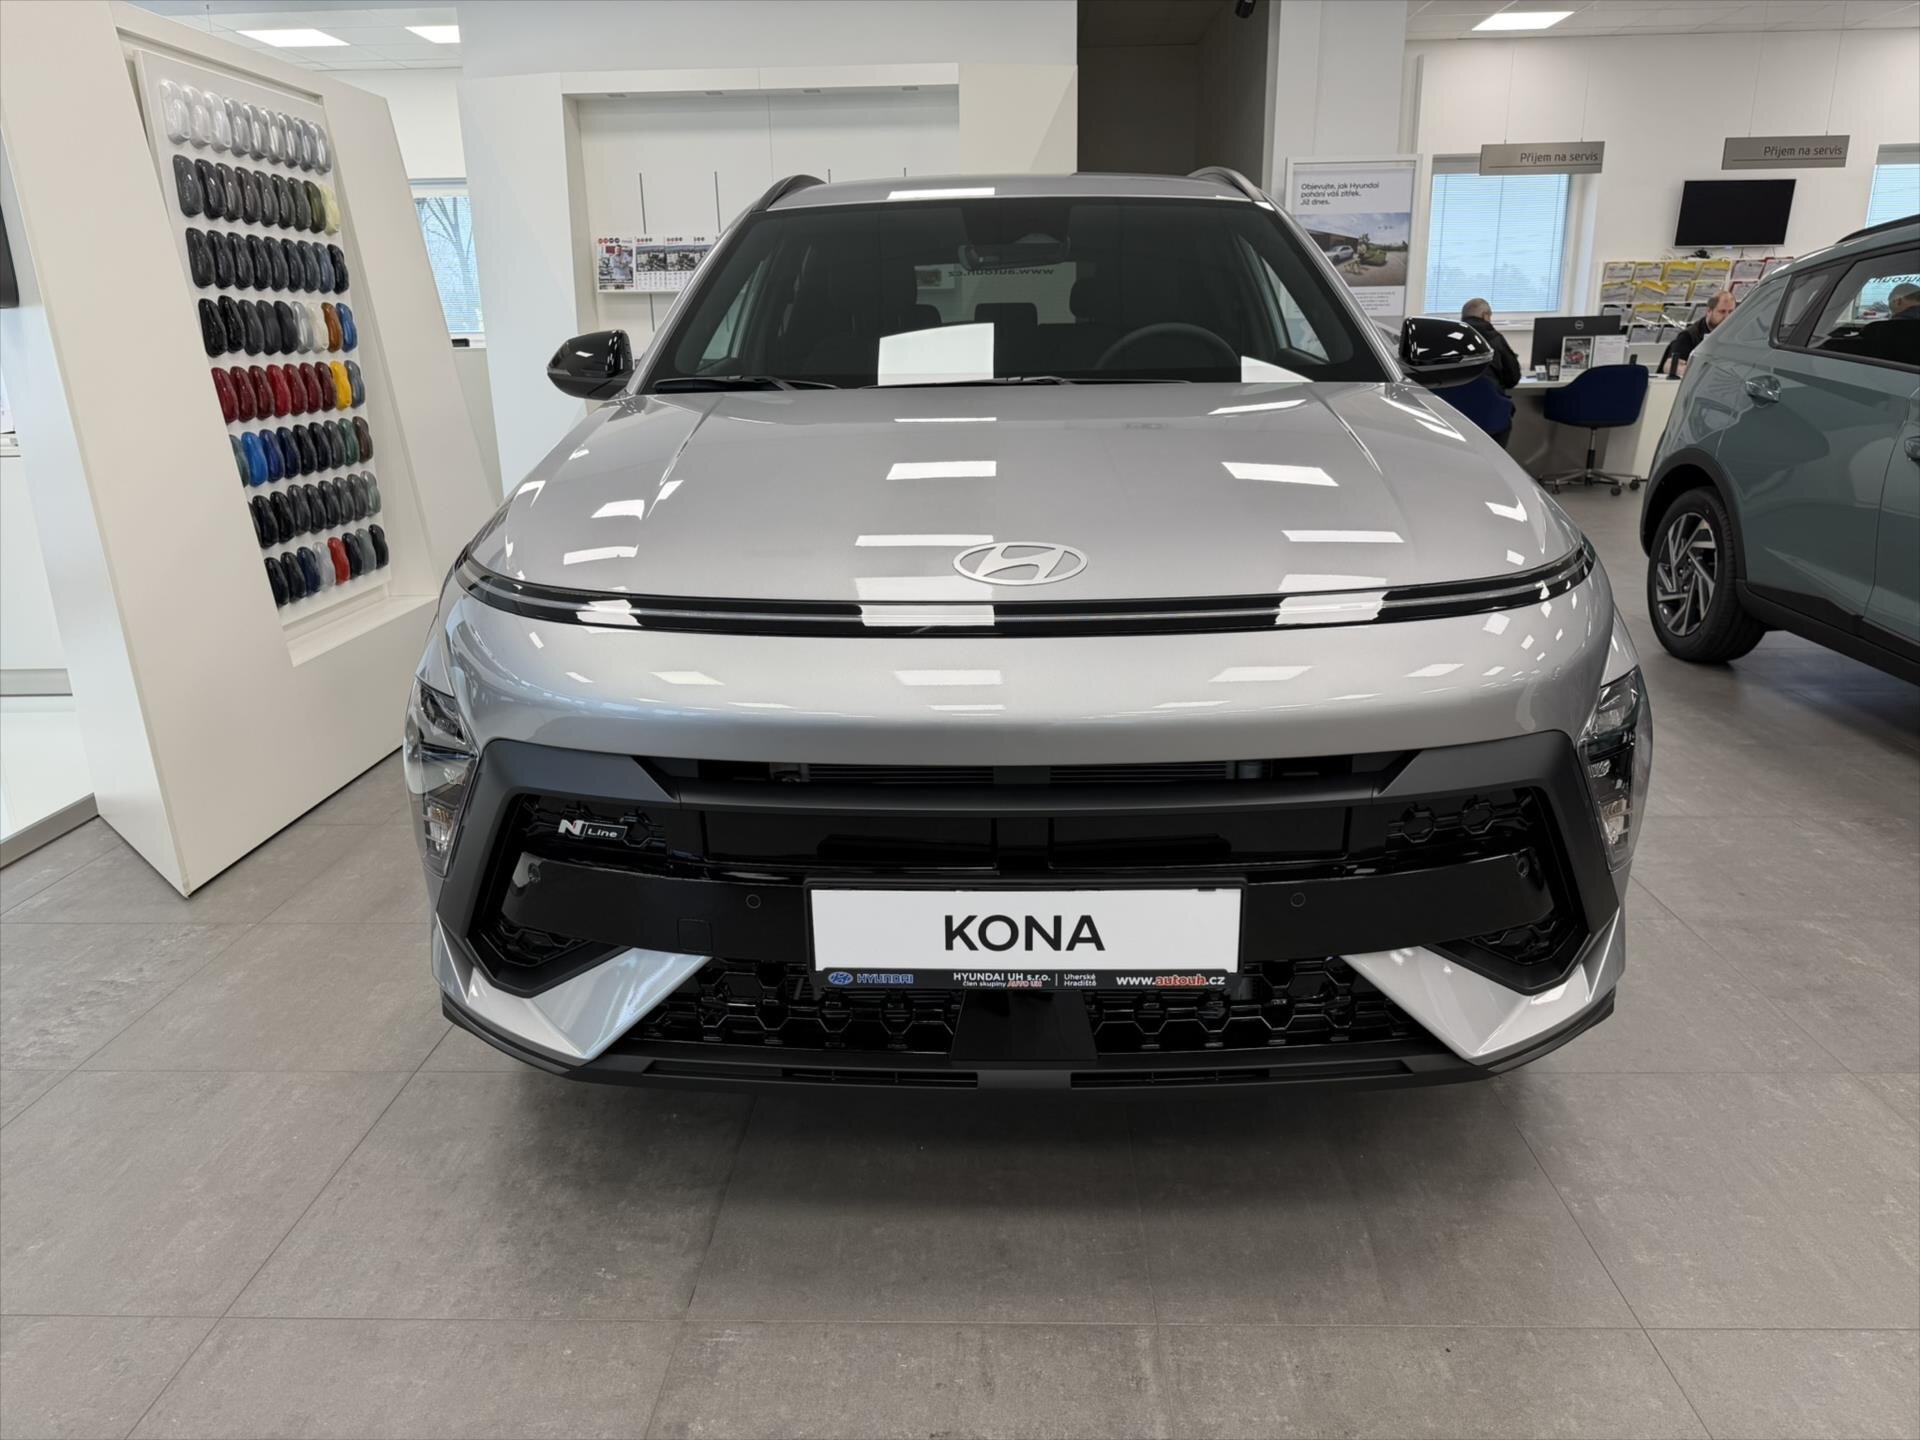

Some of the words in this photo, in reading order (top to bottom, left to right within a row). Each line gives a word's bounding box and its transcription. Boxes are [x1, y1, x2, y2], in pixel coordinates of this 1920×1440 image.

[1798, 147, 1810, 156] na
[1813, 145, 1842, 155] servis
[1554, 152, 1566, 162] na
[1569, 151, 1598, 161] servis
[1337, 183, 1348, 191] jak
[1350, 181, 1379, 189] Hyundai
[558, 819, 585, 836] N
[587, 828, 618, 838] Line
[944, 914, 1106, 952] KONA
[856, 973, 914, 984] HYUNDAI
[953, 972, 1005, 981] HYUNDAI
[1007, 972, 1023, 981] UH
[1026, 974, 1051, 982] s.r.o.
[1063, 973, 1096, 981] Uherské
[1116, 974, 1225, 986] www.autouh.cz
[980, 980, 1007, 989] skupiny
[1063, 979, 1097, 987] Hradiště
